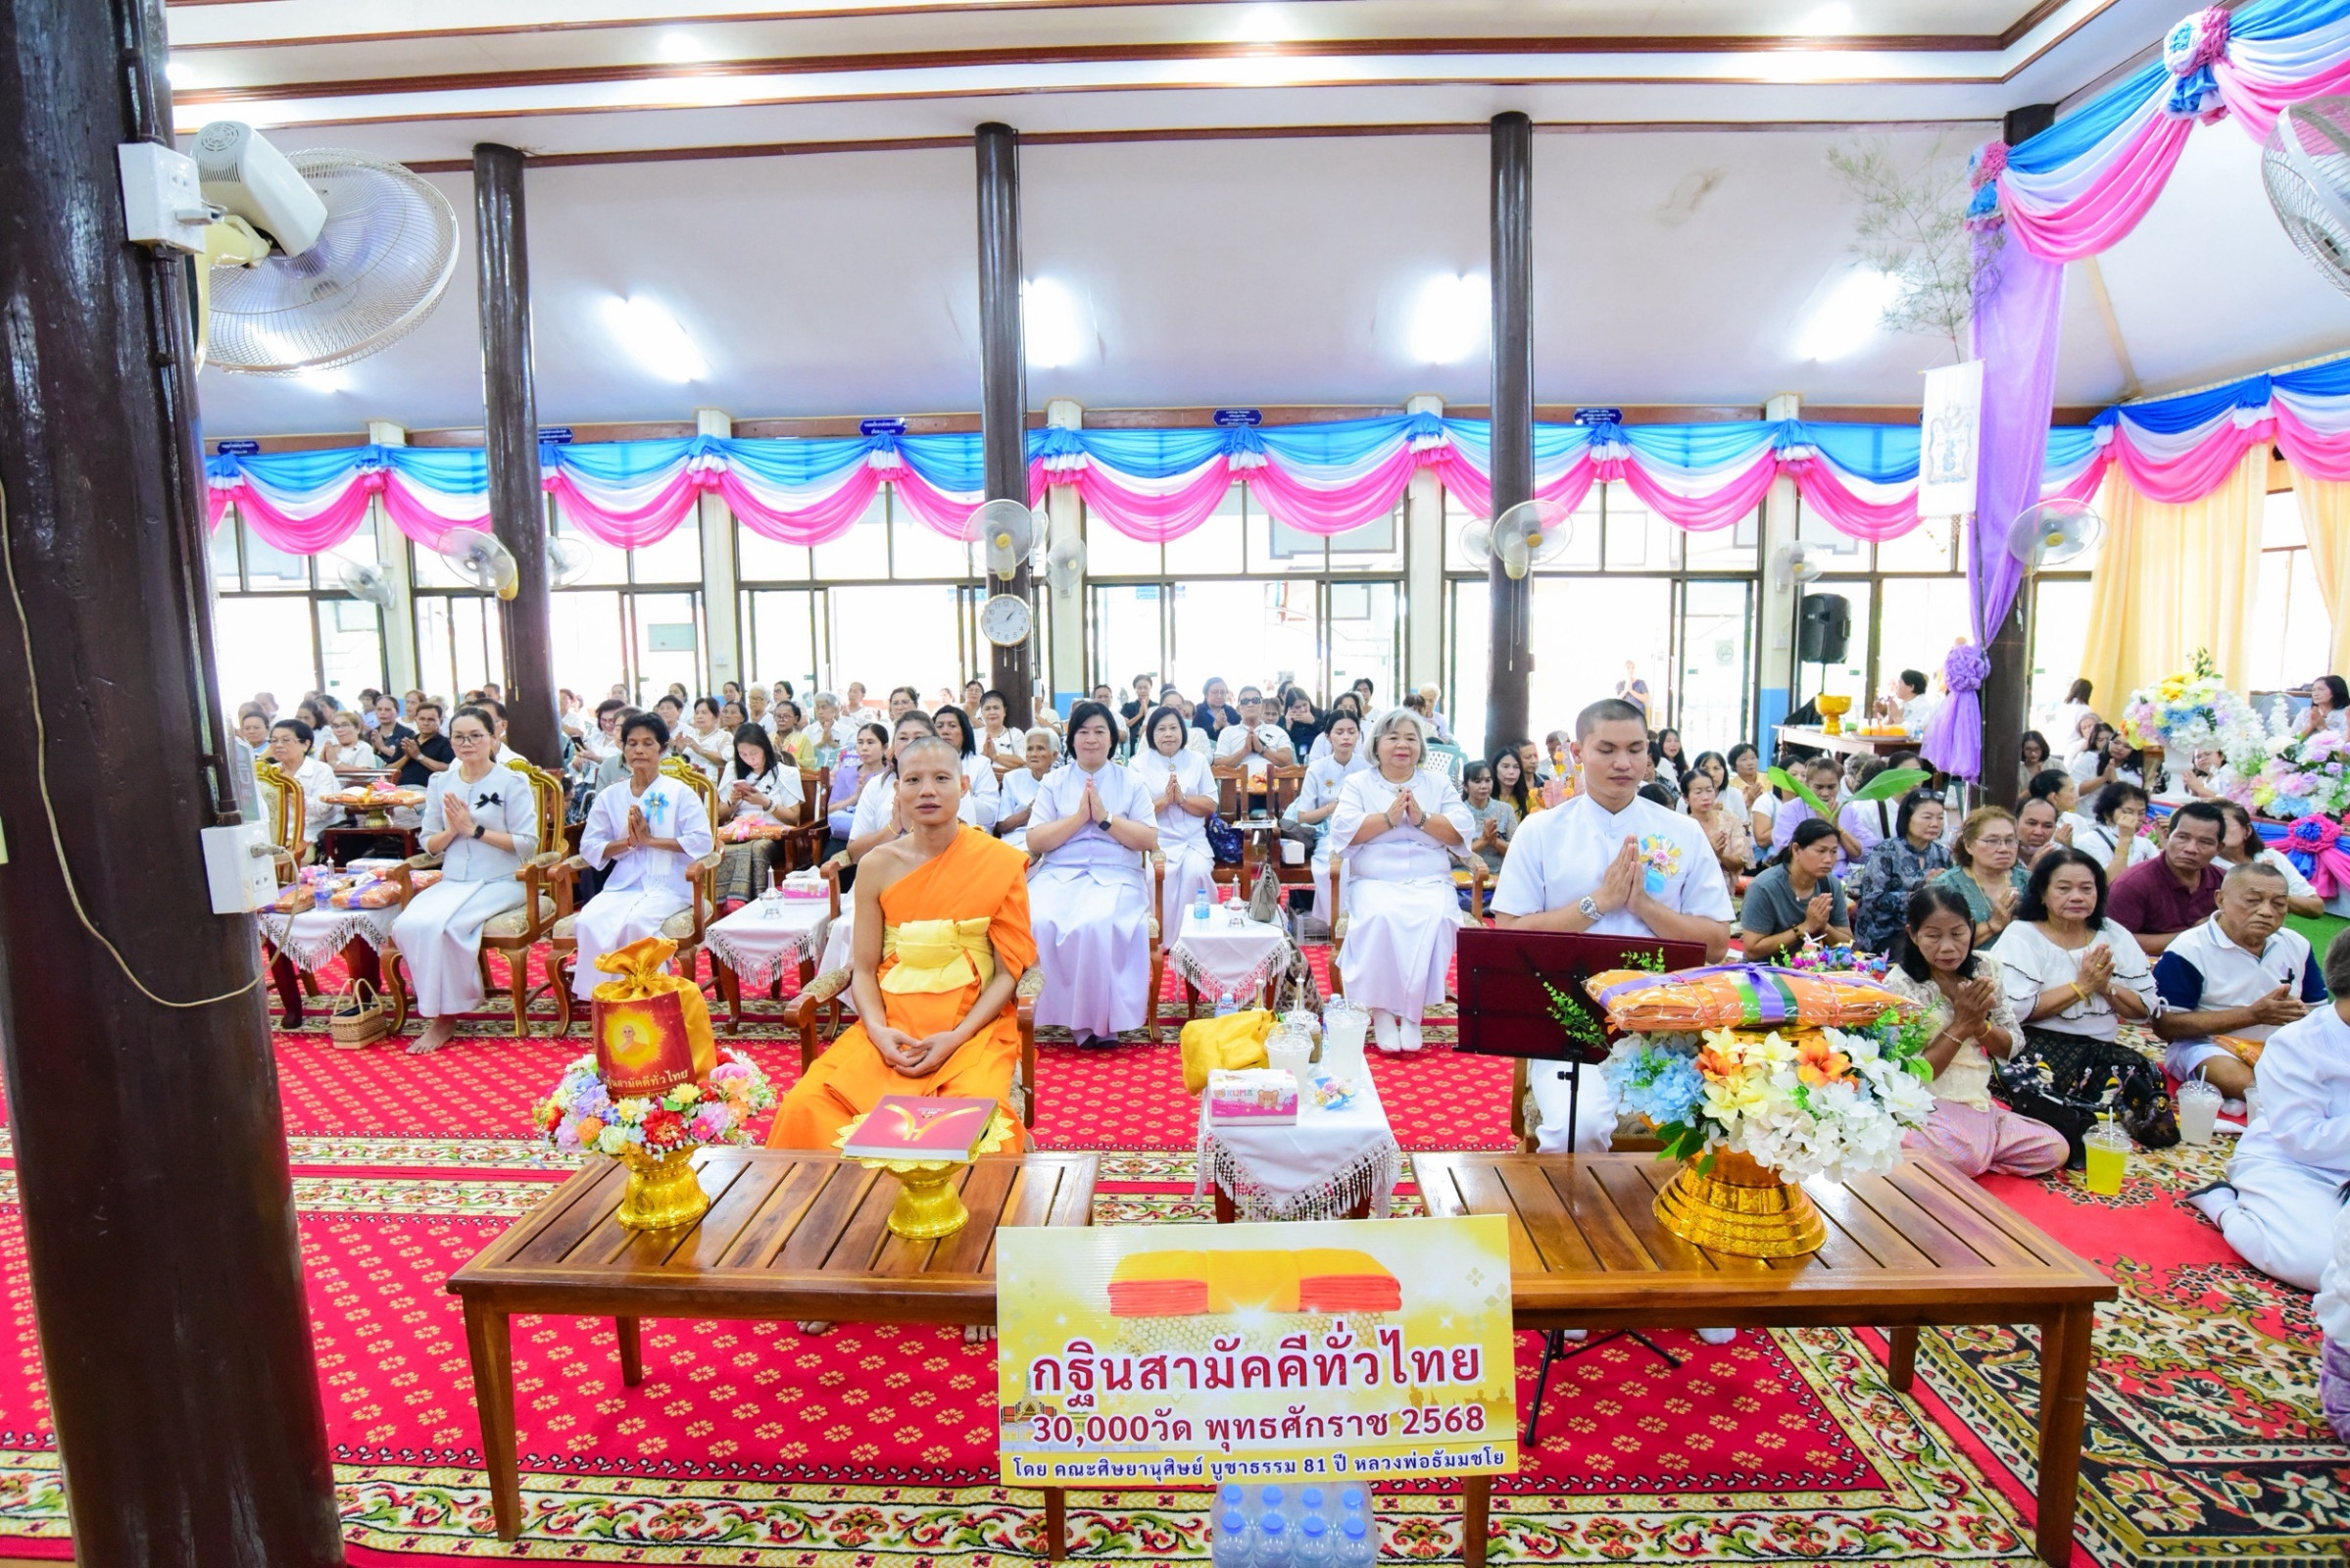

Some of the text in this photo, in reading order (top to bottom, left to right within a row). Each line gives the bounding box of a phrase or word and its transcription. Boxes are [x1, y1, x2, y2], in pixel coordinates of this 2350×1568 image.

[1032, 1321, 1480, 1408] กฐินสามัคคีทั่วไทย
[1032, 1404, 1485, 1451] 30,000วัด พุทธศักราช 2568
[1012, 1446, 1504, 1482] โดย คณะศิษยานุศิษย์ บูชาธรรม 81 ปี หลวงพ่อธัมมชโย
